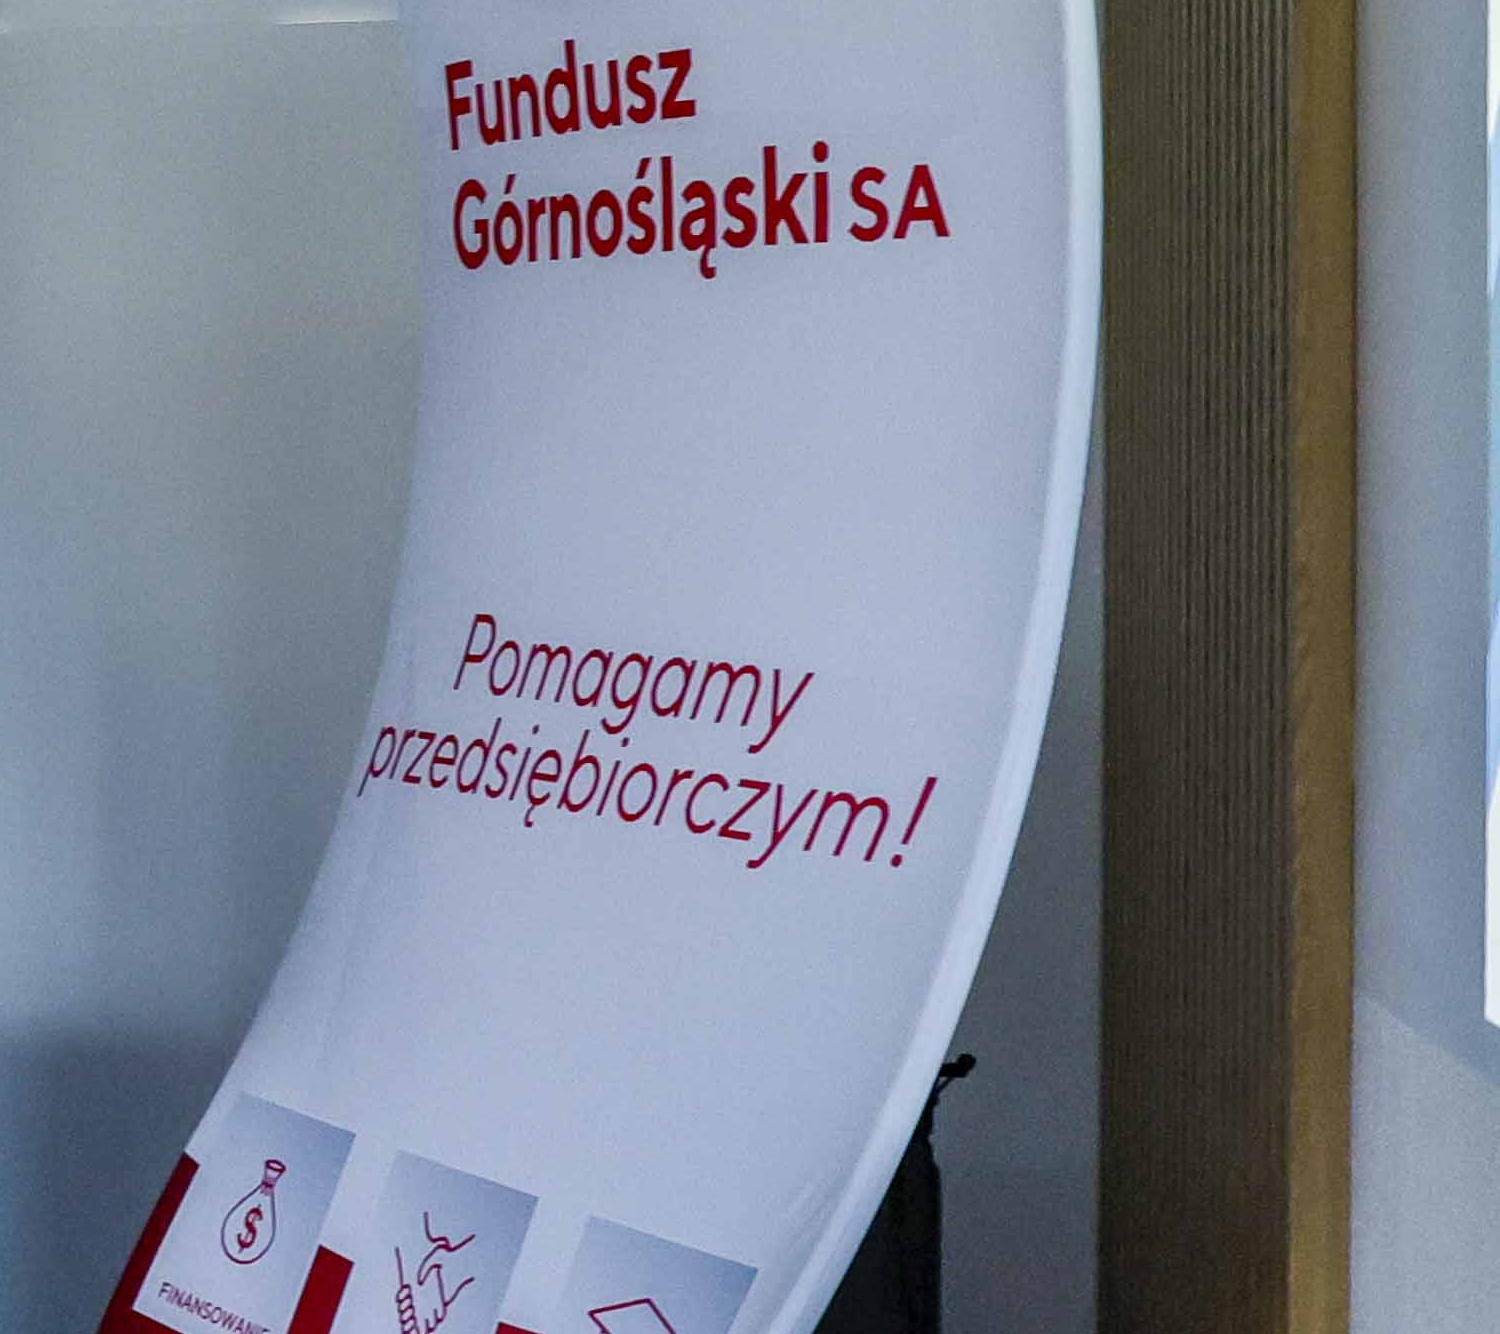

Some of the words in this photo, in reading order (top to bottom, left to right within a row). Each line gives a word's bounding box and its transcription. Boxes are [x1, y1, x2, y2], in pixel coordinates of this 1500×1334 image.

[444, 39, 696, 151] Fundusz
[453, 140, 829, 279] Górnośląski
[848, 164, 950, 243] SA
[453, 613, 814, 754] Pomagamy
[357, 716, 938, 868] przedsiębiorczym!
